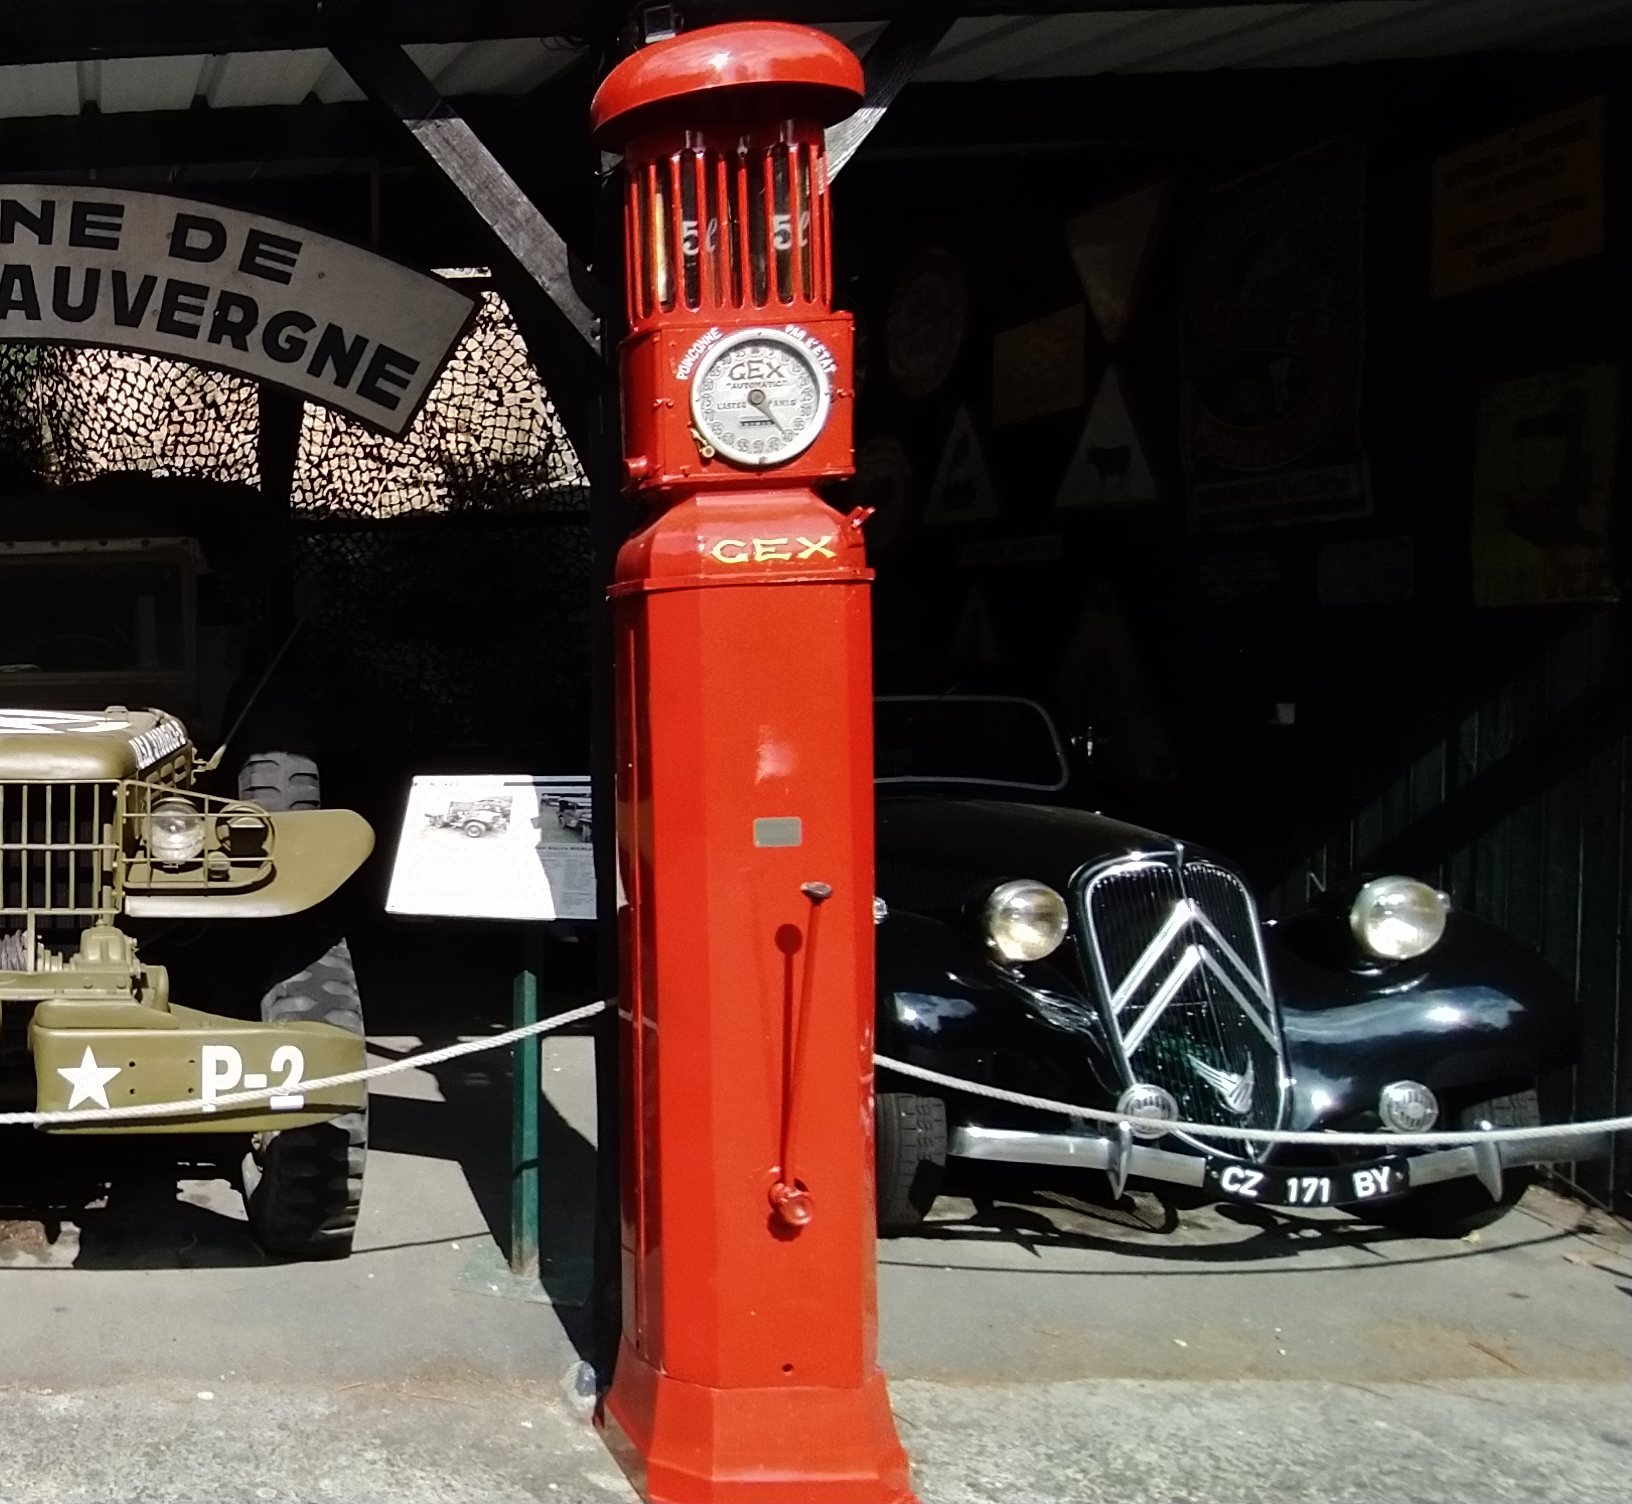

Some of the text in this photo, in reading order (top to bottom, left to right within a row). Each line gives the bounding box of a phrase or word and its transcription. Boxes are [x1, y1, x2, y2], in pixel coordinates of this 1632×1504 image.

[170, 212, 304, 286] DE
[728, 359, 786, 380] GEX
[711, 535, 837, 564] GEX
[200, 1045, 306, 1111] P-2
[1221, 1165, 1390, 1203] CZ 171 BY
